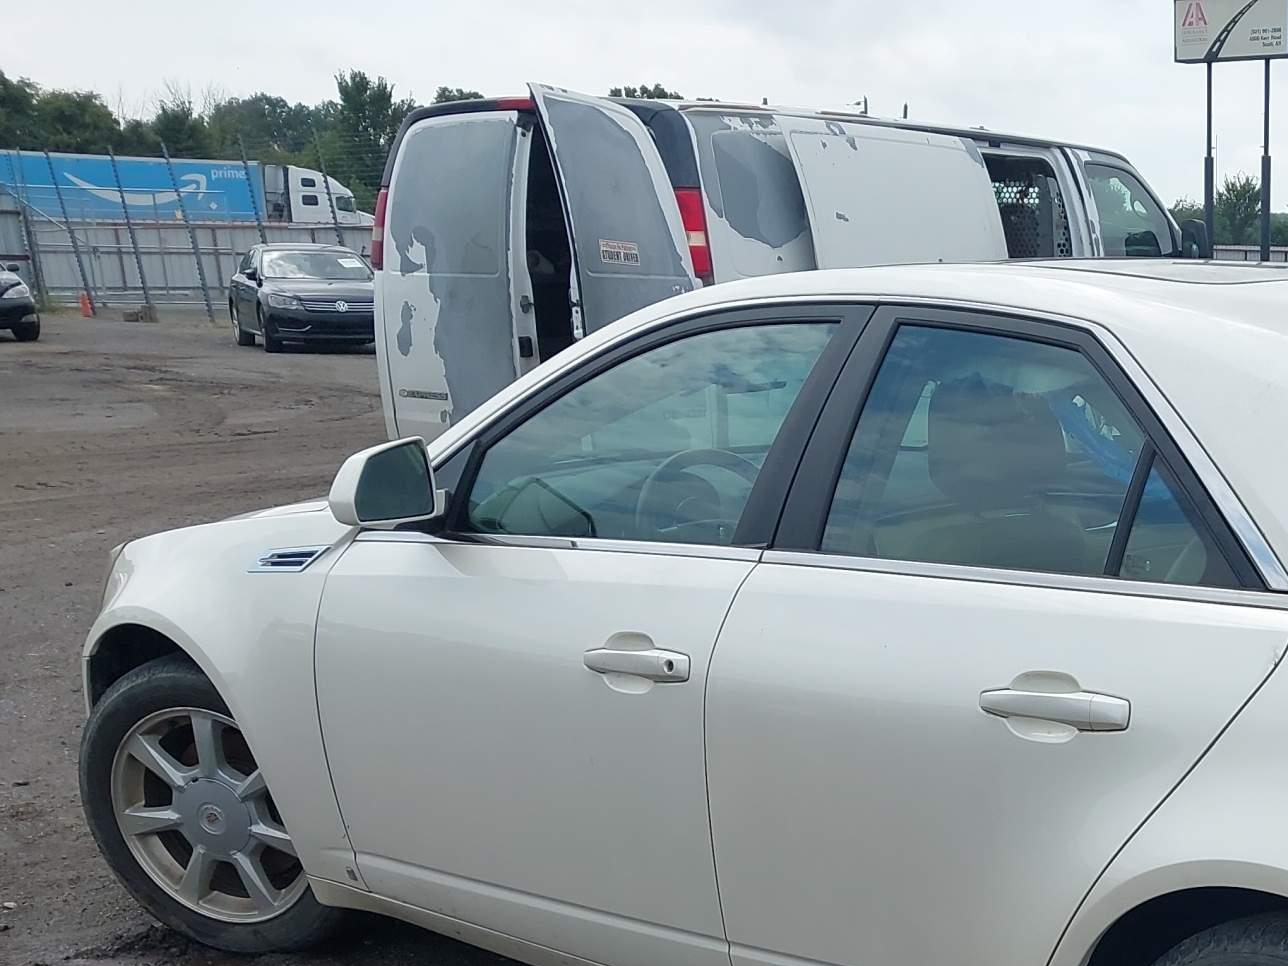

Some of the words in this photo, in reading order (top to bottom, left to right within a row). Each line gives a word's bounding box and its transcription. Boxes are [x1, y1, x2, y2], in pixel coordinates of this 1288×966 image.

[211, 167, 248, 181] prime
[602, 249, 622, 261] STUDENT
[623, 251, 639, 263] DRIVER
